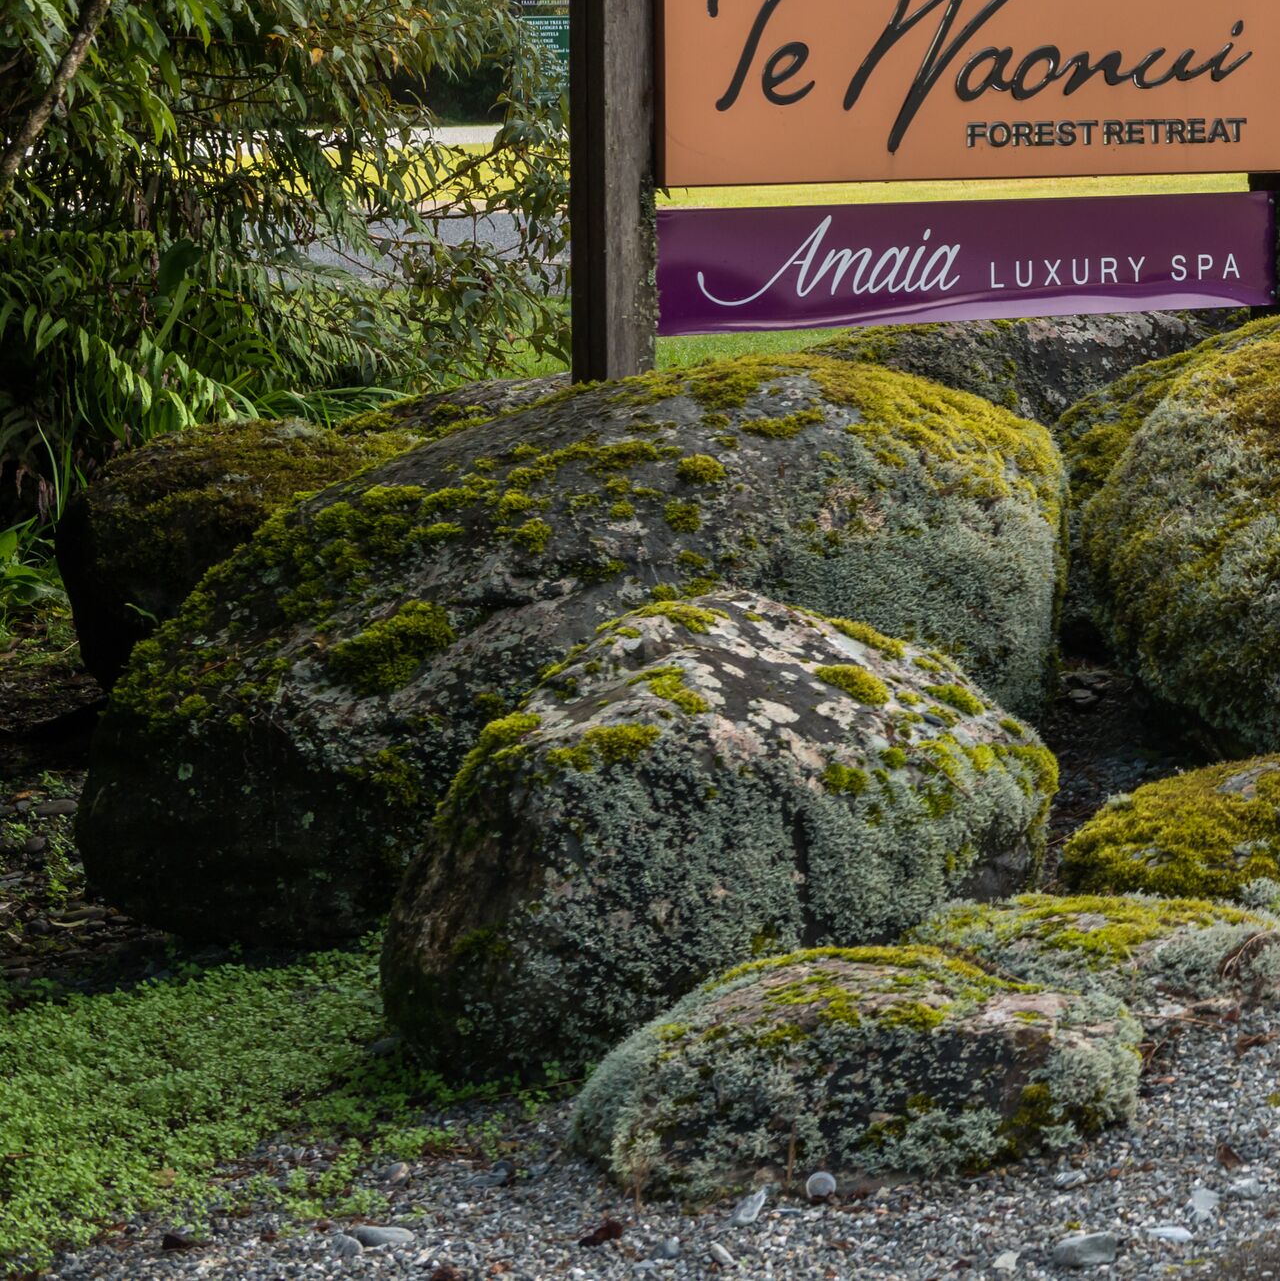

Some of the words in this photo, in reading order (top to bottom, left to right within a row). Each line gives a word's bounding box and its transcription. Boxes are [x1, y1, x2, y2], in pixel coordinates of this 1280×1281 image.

[966, 120, 1099, 148] FOREST
[1103, 117, 1248, 145] RETREAT
[697, 214, 961, 307] Amaia
[990, 256, 1145, 289] LUXURY
[1171, 253, 1241, 282] SPA
